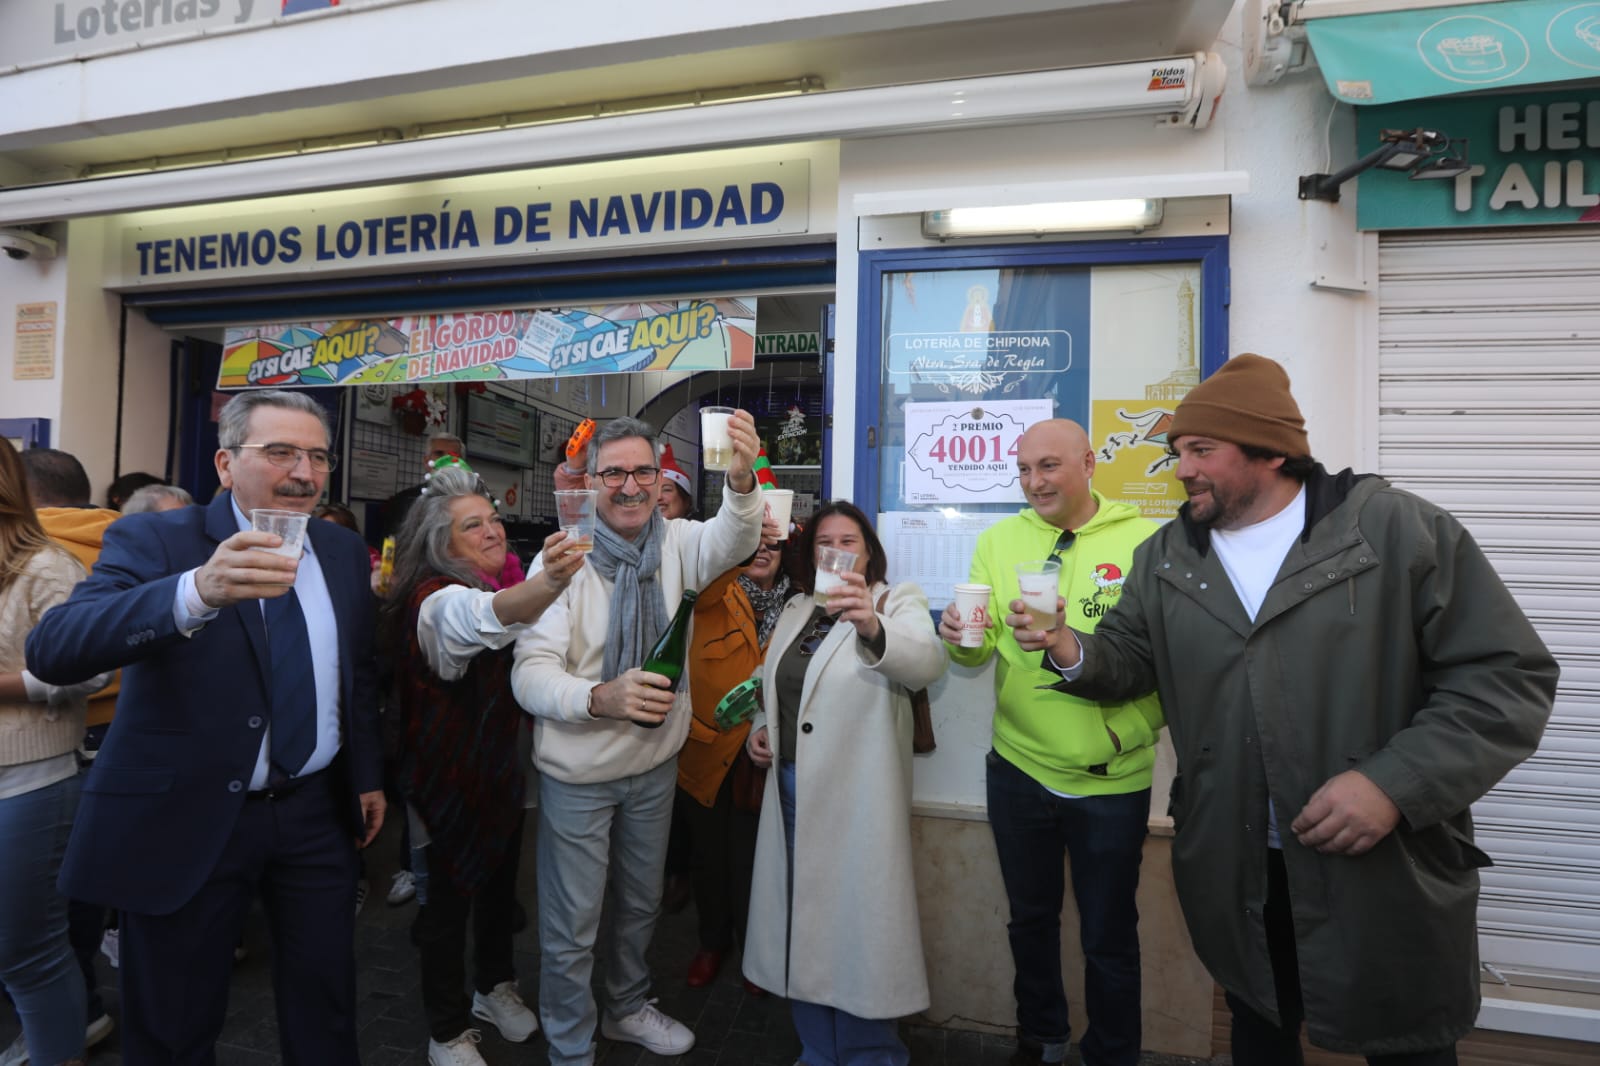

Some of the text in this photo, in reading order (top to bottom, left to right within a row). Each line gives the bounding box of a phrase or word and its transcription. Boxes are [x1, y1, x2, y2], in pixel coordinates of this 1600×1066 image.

[1152, 67, 1185, 77] Toldos
[1161, 76, 1184, 85] Toni
[136, 181, 785, 276] TENEMOS LOTERÍA DE NAVIDAD
[410, 311, 514, 355] EL GORDO
[590, 327, 630, 358] CAE
[630, 302, 716, 350] AQUÍ?
[904, 336, 1050, 349] LOTERÍA DE CHIPIONA
[280, 346, 313, 373] CAE
[312, 323, 380, 366] AQUÍ?
[756, 333, 818, 353] NTRADA
[408, 336, 517, 379] DE NAVIDAD
[987, 355, 1000, 368] de
[1003, 354, 1045, 371] Regla
[960, 422, 1003, 432] PREMIO
[929, 434, 1024, 464] 40014
